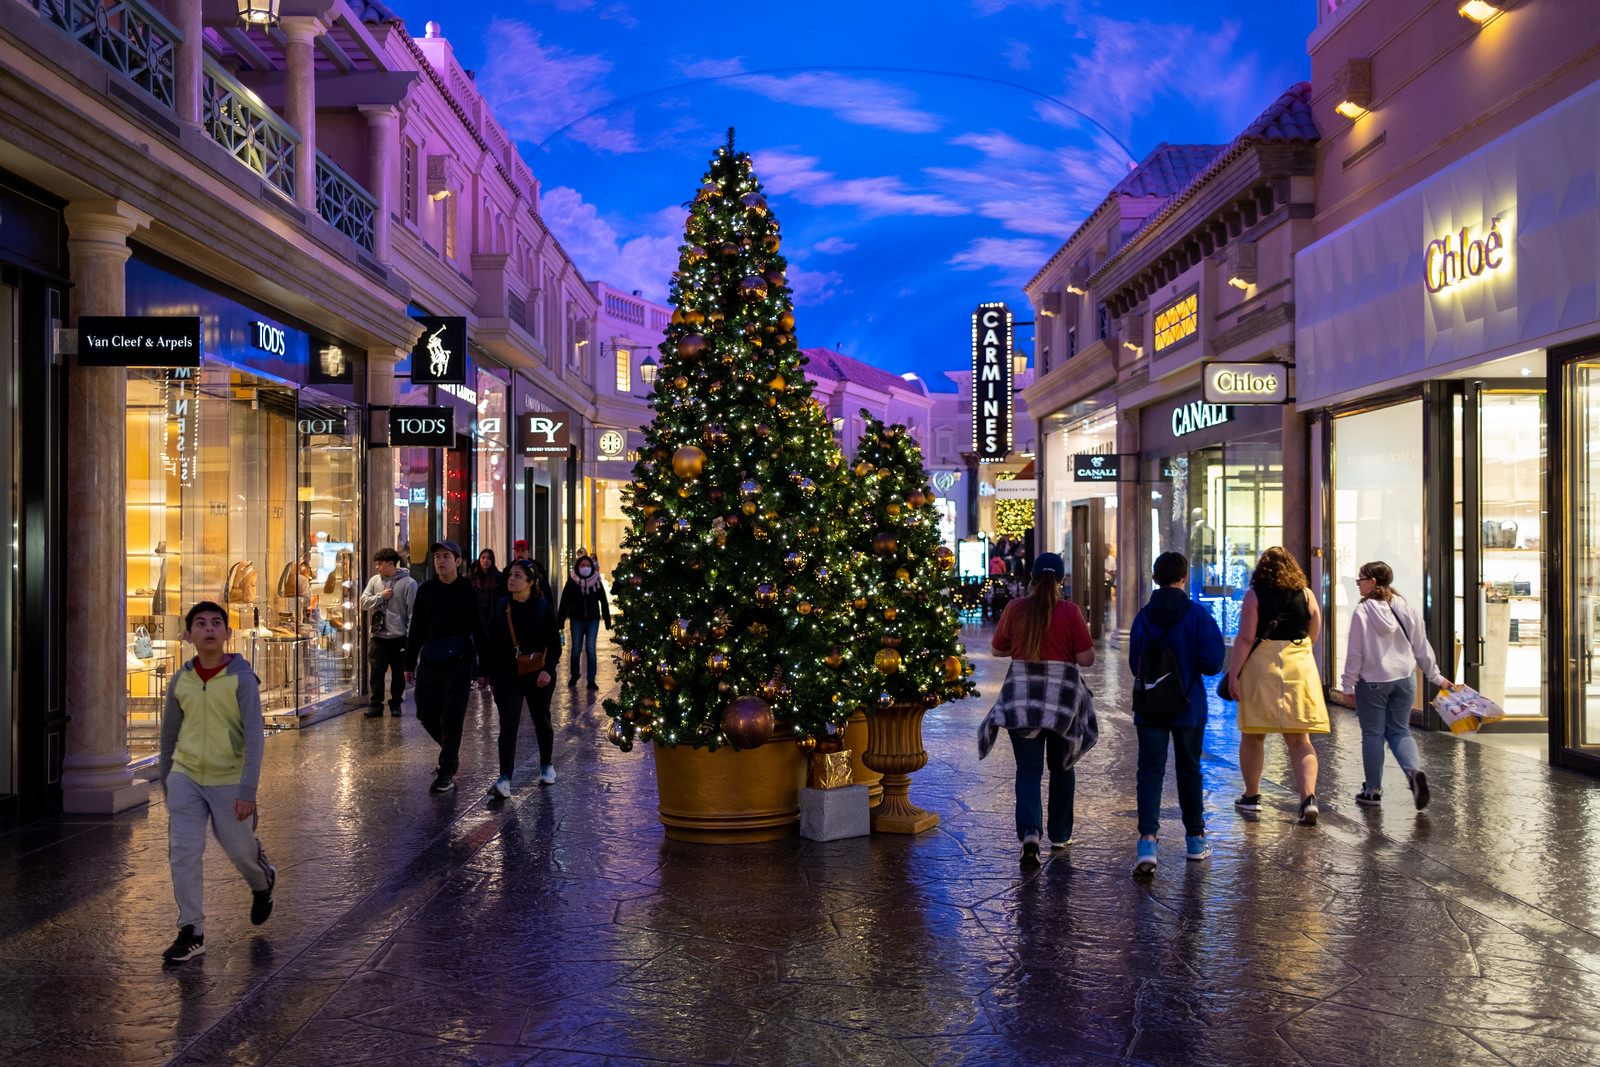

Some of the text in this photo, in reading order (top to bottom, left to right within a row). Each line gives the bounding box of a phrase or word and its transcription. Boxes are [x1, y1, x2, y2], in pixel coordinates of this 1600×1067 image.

[1424, 217, 1503, 293] Chloé
[87, 335, 193, 350] Van Cleef & Arpels
[981, 310, 1001, 453] CARMINES
[1216, 371, 1278, 392] Chloé
[397, 418, 447, 434] TOD'S
[530, 417, 564, 443] DY
[1172, 400, 1228, 437] CANALI
[1077, 468, 1118, 477] CANALI
